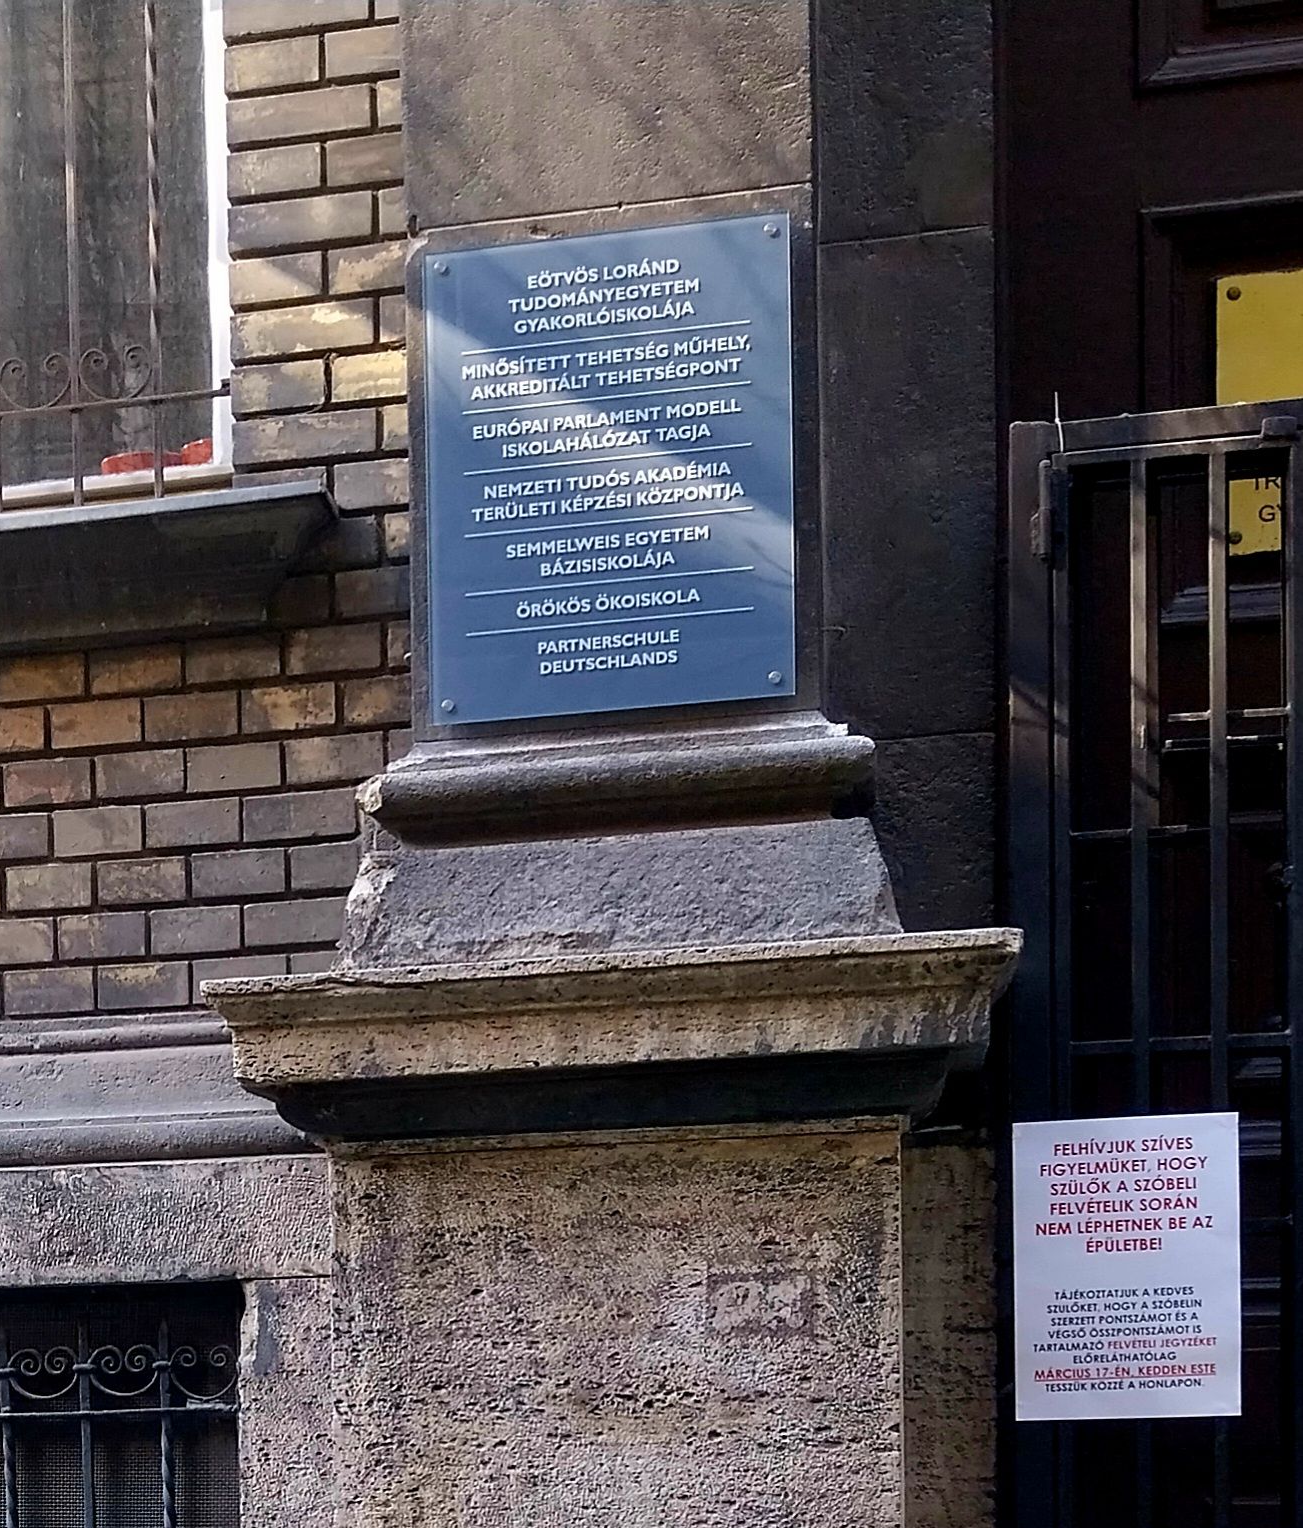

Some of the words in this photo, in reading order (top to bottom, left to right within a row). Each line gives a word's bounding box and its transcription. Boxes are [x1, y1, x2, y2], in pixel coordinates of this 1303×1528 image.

[527, 268, 599, 290] EÖTVÖS
[603, 258, 680, 281] LORÁND
[508, 277, 700, 313] TUDOMÁNYEGYETEM
[513, 300, 695, 334] GYAKORLÓISKOLÁJA
[461, 354, 571, 380] MINŐSÍTETT
[576, 342, 670, 367] TEHETSÉG
[673, 333, 751, 356] MŰHELY,
[470, 373, 592, 401] AKKREDITÁLT
[595, 358, 741, 387] TEHETSÉGPONT
[472, 418, 550, 440] EURÓPAI
[553, 406, 662, 431] PARLAMENT
[665, 398, 742, 420] MODELL
[501, 429, 651, 458] ISKOLAHÁLÓZAT
[655, 425, 711, 444] TAGJA
[483, 478, 563, 500] NEMZETI
[566, 469, 630, 494] TUDÓS
[633, 461, 732, 485] AKADÉMIA
[471, 498, 556, 523] TERÜLETI
[560, 490, 632, 514] KÉPZÉSI
[636, 481, 745, 506] KÖZPONTJA
[506, 533, 620, 559] SEMMELWEIS
[625, 524, 710, 548] EGYETEM
[539, 549, 675, 577] BÁZISISKOLÁJA
[516, 593, 591, 619] ÖRÖKÖS
[595, 587, 700, 611] ÖKOISKOLA
[537, 629, 680, 654] PARTNERSCHULE
[539, 649, 678, 675] DEUTSCHLANDS
[1053, 1138, 1136, 1157] FELHÍVJUK
[1141, 1135, 1193, 1152] SZÍVES
[1157, 1156, 1208, 1171] HOGY
[1050, 1178, 1111, 1196] SZÜLŐK
[1116, 1180, 1128, 1193] A
[1134, 1174, 1197, 1191] SZÓBELI
[1050, 1197, 1134, 1216] FELVÉTELIK
[1139, 1193, 1198, 1212] SORÁN
[1035, 1223, 1072, 1236] NEM
[1077, 1217, 1163, 1234] LÉPHETNEK
[1168, 1216, 1187, 1230] BE
[1192, 1215, 1213, 1229] AZ
[1085, 1237, 1162, 1253] ÉPÜLETBE!
[1054, 1287, 1139, 1301] TÁJÉKOZTATJUK
[1142, 1287, 1150, 1297] A
[1153, 1286, 1194, 1297] KEDVES
[1103, 1301, 1137, 1311] HOGY
[1140, 1300, 1149, 1310] A
[1152, 1298, 1203, 1309] SZÓBELIN
[1050, 1315, 1096, 1327] SZERZETT
[1099, 1311, 1172, 1325] PONTSZÁMOT
[1175, 1309, 1187, 1321] ÉS
[1190, 1311, 1198, 1320] A
[1192, 1324, 1202, 1334] IS
[1107, 1338, 1157, 1350] FELVÉTELI
[1159, 1336, 1217, 1349] JEGYZÉKET
[1073, 1350, 1177, 1364] ELŐRELÁTHATÓLAG
[1034, 1366, 1091, 1379] MÁRCIUS
[1095, 1364, 1135, 1378] 17-ÉN,
[1138, 1365, 1186, 1376] KEDDEN
[1190, 1363, 1216, 1373] ESTE
[1045, 1380, 1087, 1392] TESSZÜK
[1127, 1380, 1136, 1390] A
